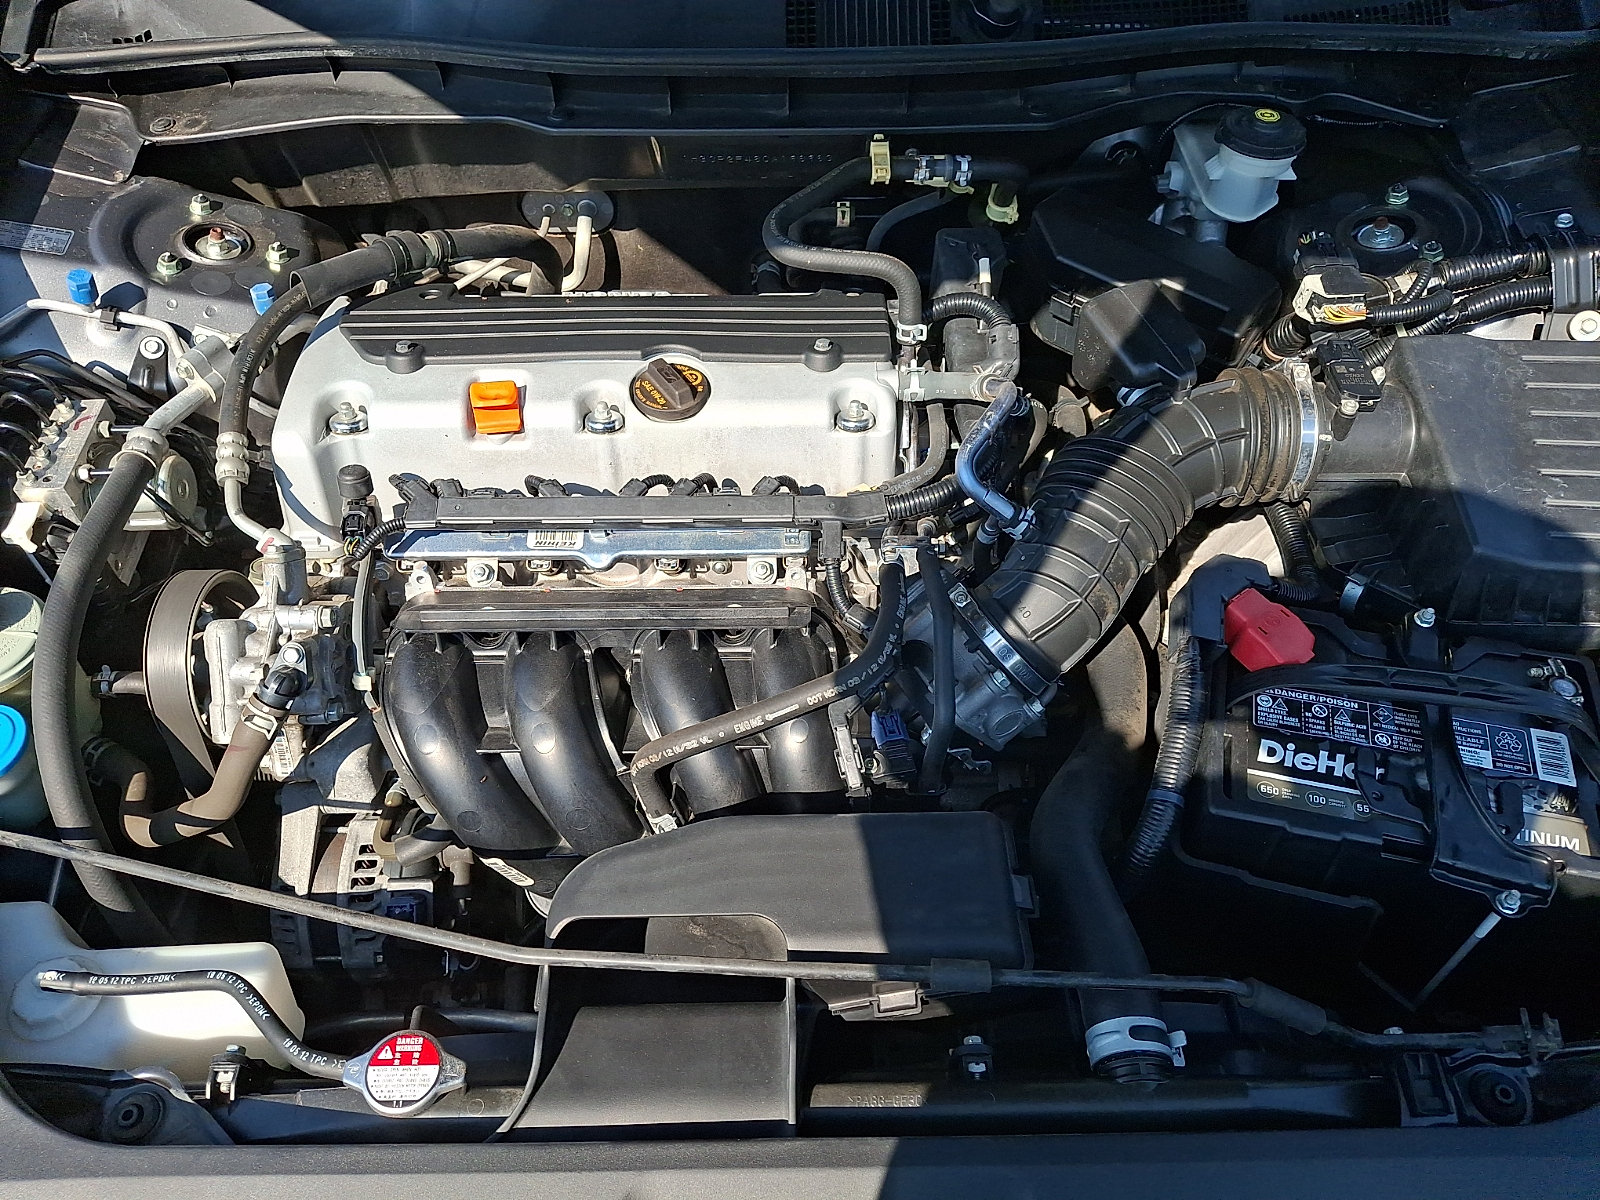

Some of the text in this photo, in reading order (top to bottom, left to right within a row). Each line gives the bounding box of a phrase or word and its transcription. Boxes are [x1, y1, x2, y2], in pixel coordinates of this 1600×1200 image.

[641, 380, 653, 392] SAE
[806, 692, 823, 706] DOT
[1272, 688, 1359, 709] DANGER/POISON
[734, 716, 764, 734] ENGINE
[1260, 784, 1280, 796] 650
[1308, 794, 1326, 805] 100
[98, 976, 109, 985] 05
[110, 976, 120, 985] 12
[120, 976, 137, 985] TPC
[226, 974, 236, 984] 12
[233, 979, 248, 994] TPC
[396, 1037, 424, 1045] DANGER
[289, 1044, 301, 1056] 05
[299, 1050, 310, 1061] 12
[310, 1053, 328, 1066] TPC
